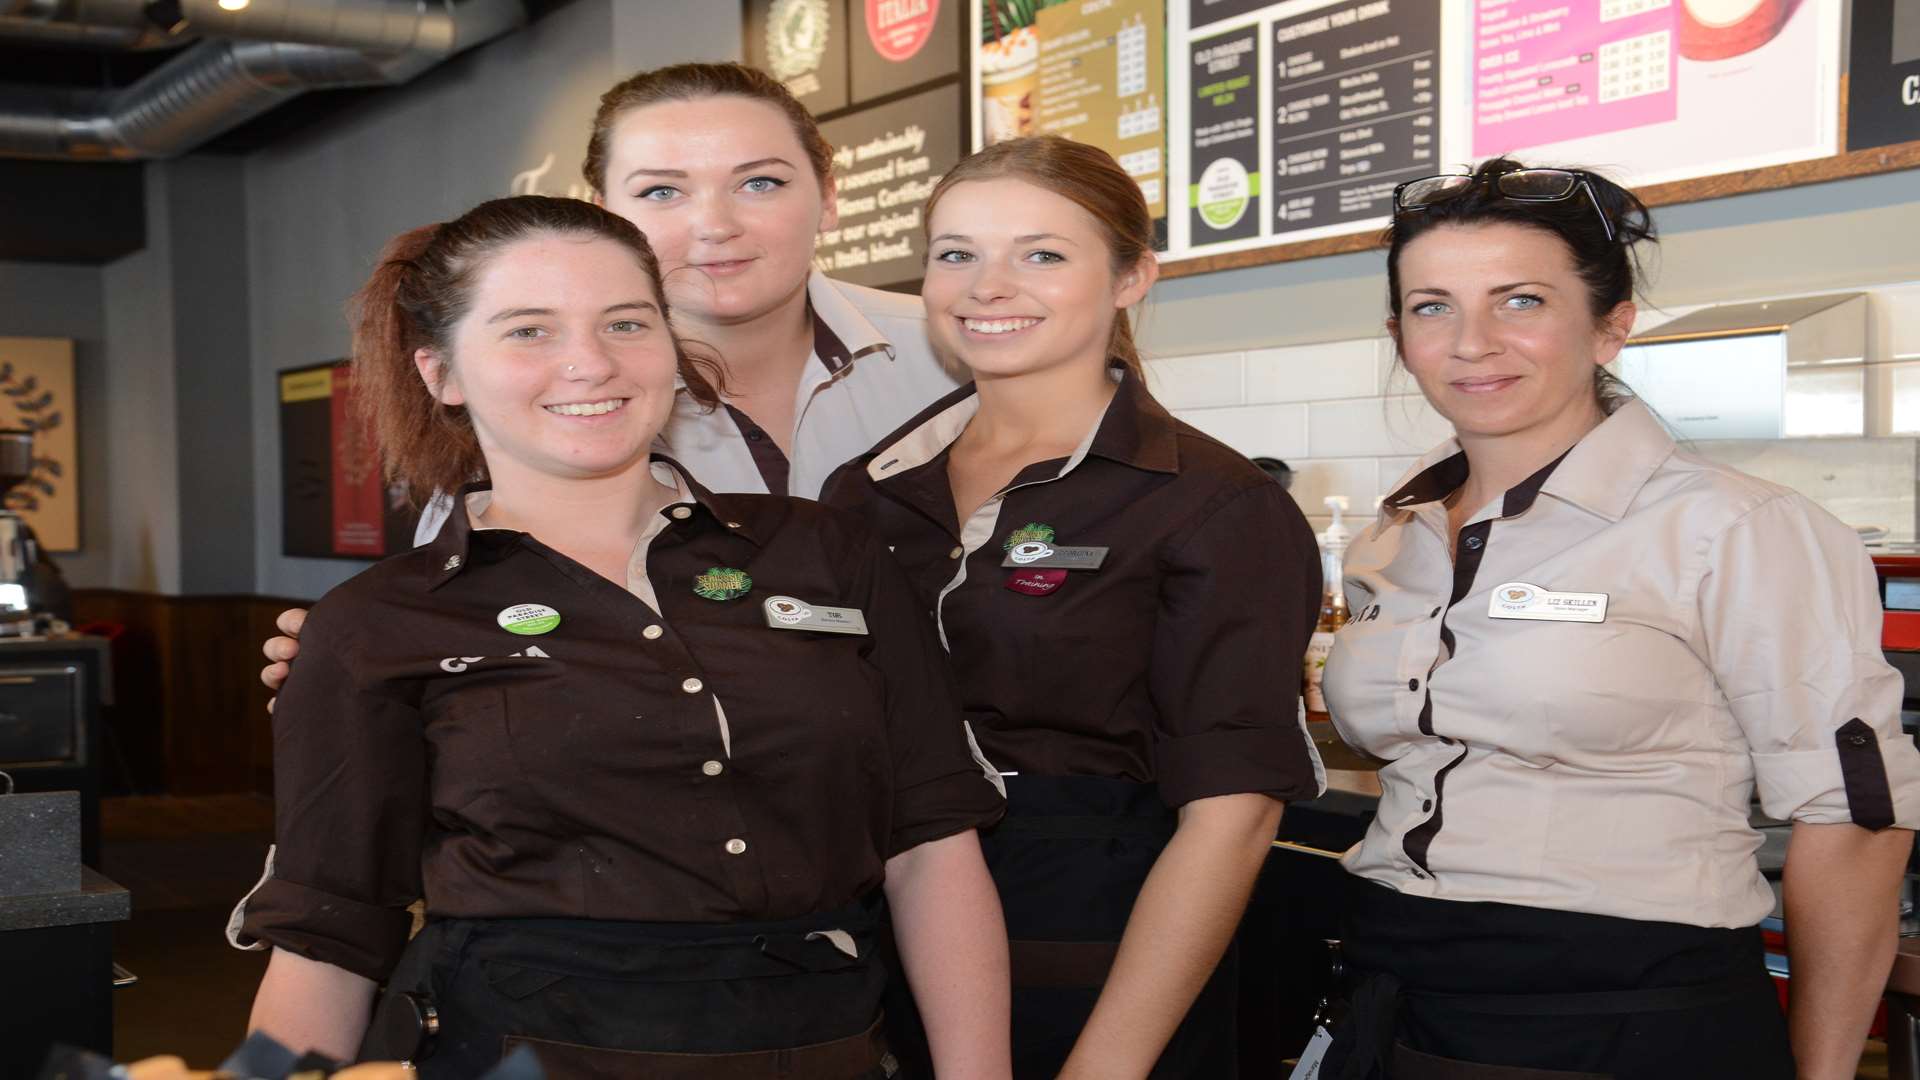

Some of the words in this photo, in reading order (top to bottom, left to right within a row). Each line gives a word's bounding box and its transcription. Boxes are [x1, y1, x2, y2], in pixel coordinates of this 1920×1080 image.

[1331, 8, 1356, 28] YOUR
[1357, 0, 1391, 21] DRINK
[1278, 61, 1287, 78] 1
[1278, 106, 1287, 124] 2
[896, 156, 930, 177] from
[1278, 158, 1287, 176] 3
[1278, 203, 1287, 220] 4
[867, 207, 920, 238] original
[703, 581, 741, 590] SUMMER
